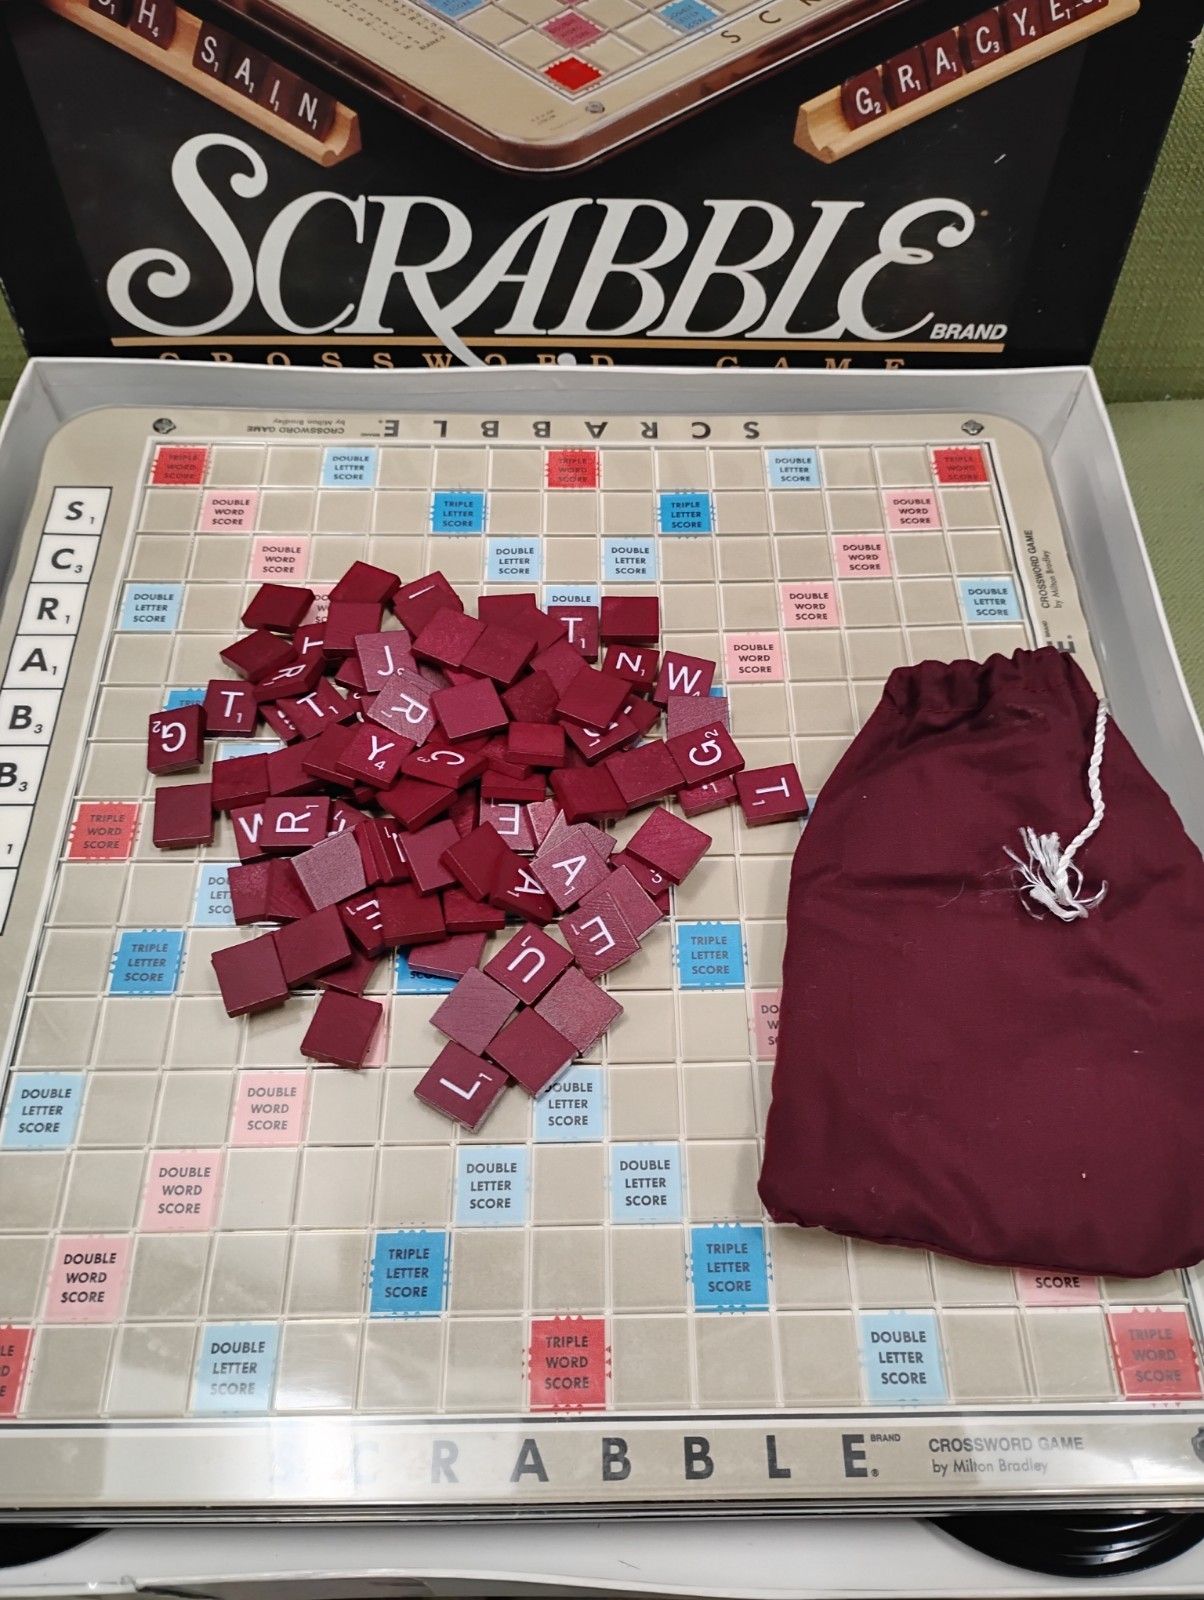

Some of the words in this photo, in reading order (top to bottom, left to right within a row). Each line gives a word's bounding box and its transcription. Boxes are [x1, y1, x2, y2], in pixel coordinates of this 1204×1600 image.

[107, 133, 975, 368] SCRABBLE
[930, 323, 1008, 341] BRAND
[246, 425, 276, 433] GAME
[278, 425, 345, 435] CROSSWORD
[558, 457, 588, 465] TRIPLE
[558, 466, 588, 474] WORD
[780, 466, 809, 474] LETTER
[163, 472, 195, 480] SCORE
[333, 473, 364, 481] SCORE
[443, 500, 474, 508] TRIPLE
[670, 501, 700, 509] TRIPLE
[893, 498, 931, 506] DOUBLE
[214, 508, 245, 516] WORD
[443, 510, 474, 518] LETTER
[898, 507, 928, 515] WORD
[900, 517, 931, 525] SCORE
[1024, 529, 1037, 554] GAME
[262, 546, 301, 554] DOUBLE
[495, 547, 535, 555] DOUBLE
[611, 547, 650, 555] DOUBLE
[499, 557, 530, 565] LETTER
[615, 557, 647, 565] LETTER
[262, 566, 295, 574] SCORE
[498, 567, 530, 575] SCORE
[615, 567, 647, 575] SCORE
[849, 563, 881, 571] SCORE
[1029, 555, 1051, 608] CROSSWORD
[134, 593, 174, 601] DOUBLE
[789, 592, 829, 600] DOUBLE
[967, 588, 1008, 596] DOUBLE
[552, 595, 591, 603] DOUBLE
[973, 598, 1006, 606] LETTER
[135, 604, 168, 612] LETTER
[794, 603, 826, 611] WORD
[976, 608, 1009, 616] SCORE
[133, 615, 166, 623] SCORE
[795, 613, 828, 621] SCORE
[733, 643, 774, 651] DOUBLE
[738, 654, 771, 662] WORD
[738, 665, 772, 674] SCORE
[89, 814, 125, 823] TRIPLE
[87, 827, 122, 836] WORD
[83, 840, 120, 849] SCORE
[210, 890, 231, 900] LET
[208, 905, 232, 914] SCO
[691, 936, 727, 945] TRIPLE
[131, 943, 169, 952] TRIPLE
[691, 951, 729, 960] LETTER
[127, 958, 166, 967] LETTER
[692, 965, 730, 975] SCORE
[124, 972, 164, 982] SCORE
[21, 1088, 72, 1099] DOUBLE
[247, 1087, 297, 1097] DOUBLE
[250, 1104, 289, 1114] WORD
[548, 1099, 588, 1109] LETTER
[21, 1105, 63, 1116] LETTER
[247, 1120, 288, 1131] SCORE
[548, 1115, 588, 1126] SCORE
[18, 1122, 60, 1133] SCORE
[466, 1162, 517, 1174] DOUBLE
[619, 1159, 671, 1171] DOUBLE
[158, 1167, 211, 1178] DOUBLE
[470, 1181, 511, 1192] LETTER
[625, 1177, 666, 1189] LETTER
[162, 1185, 203, 1196] WORD
[469, 1197, 511, 1209] SCORE
[625, 1195, 667, 1206] SCORE
[158, 1203, 201, 1214] SCORE
[388, 1248, 430, 1260] TRIPLE
[706, 1243, 748, 1255] TRIPLE
[63, 1253, 117, 1265] DOUBLE
[707, 1262, 750, 1273] LETTER
[65, 1272, 107, 1284] WORD
[386, 1267, 429, 1279] LETTER
[708, 1281, 752, 1293] SCORE
[1035, 1277, 1080, 1289] SCORE
[60, 1291, 105, 1303] SCORE
[385, 1286, 428, 1298] SCORE
[871, 1331, 927, 1343] DOUBLE
[1128, 1328, 1173, 1340] TRIPLE
[545, 1336, 588, 1348] TRIPLE
[210, 1341, 266, 1354] DOUBLE
[878, 1352, 924, 1364] LETTER
[1131, 1349, 1176, 1361] WORD
[545, 1356, 588, 1368] WORD
[213, 1362, 258, 1374] LETTER
[881, 1372, 927, 1385] SCORE
[1135, 1369, 1183, 1382] SCORE
[544, 1377, 590, 1390] SCORE
[210, 1383, 255, 1396] SCORE
[870, 1433, 901, 1442] BRAND
[928, 1437, 1033, 1453] CROSSWORD
[1038, 1436, 1085, 1450] GAME
[932, 1459, 949, 1477] by
[953, 1459, 994, 1473] Milton
[998, 1458, 1048, 1475] Bradley
